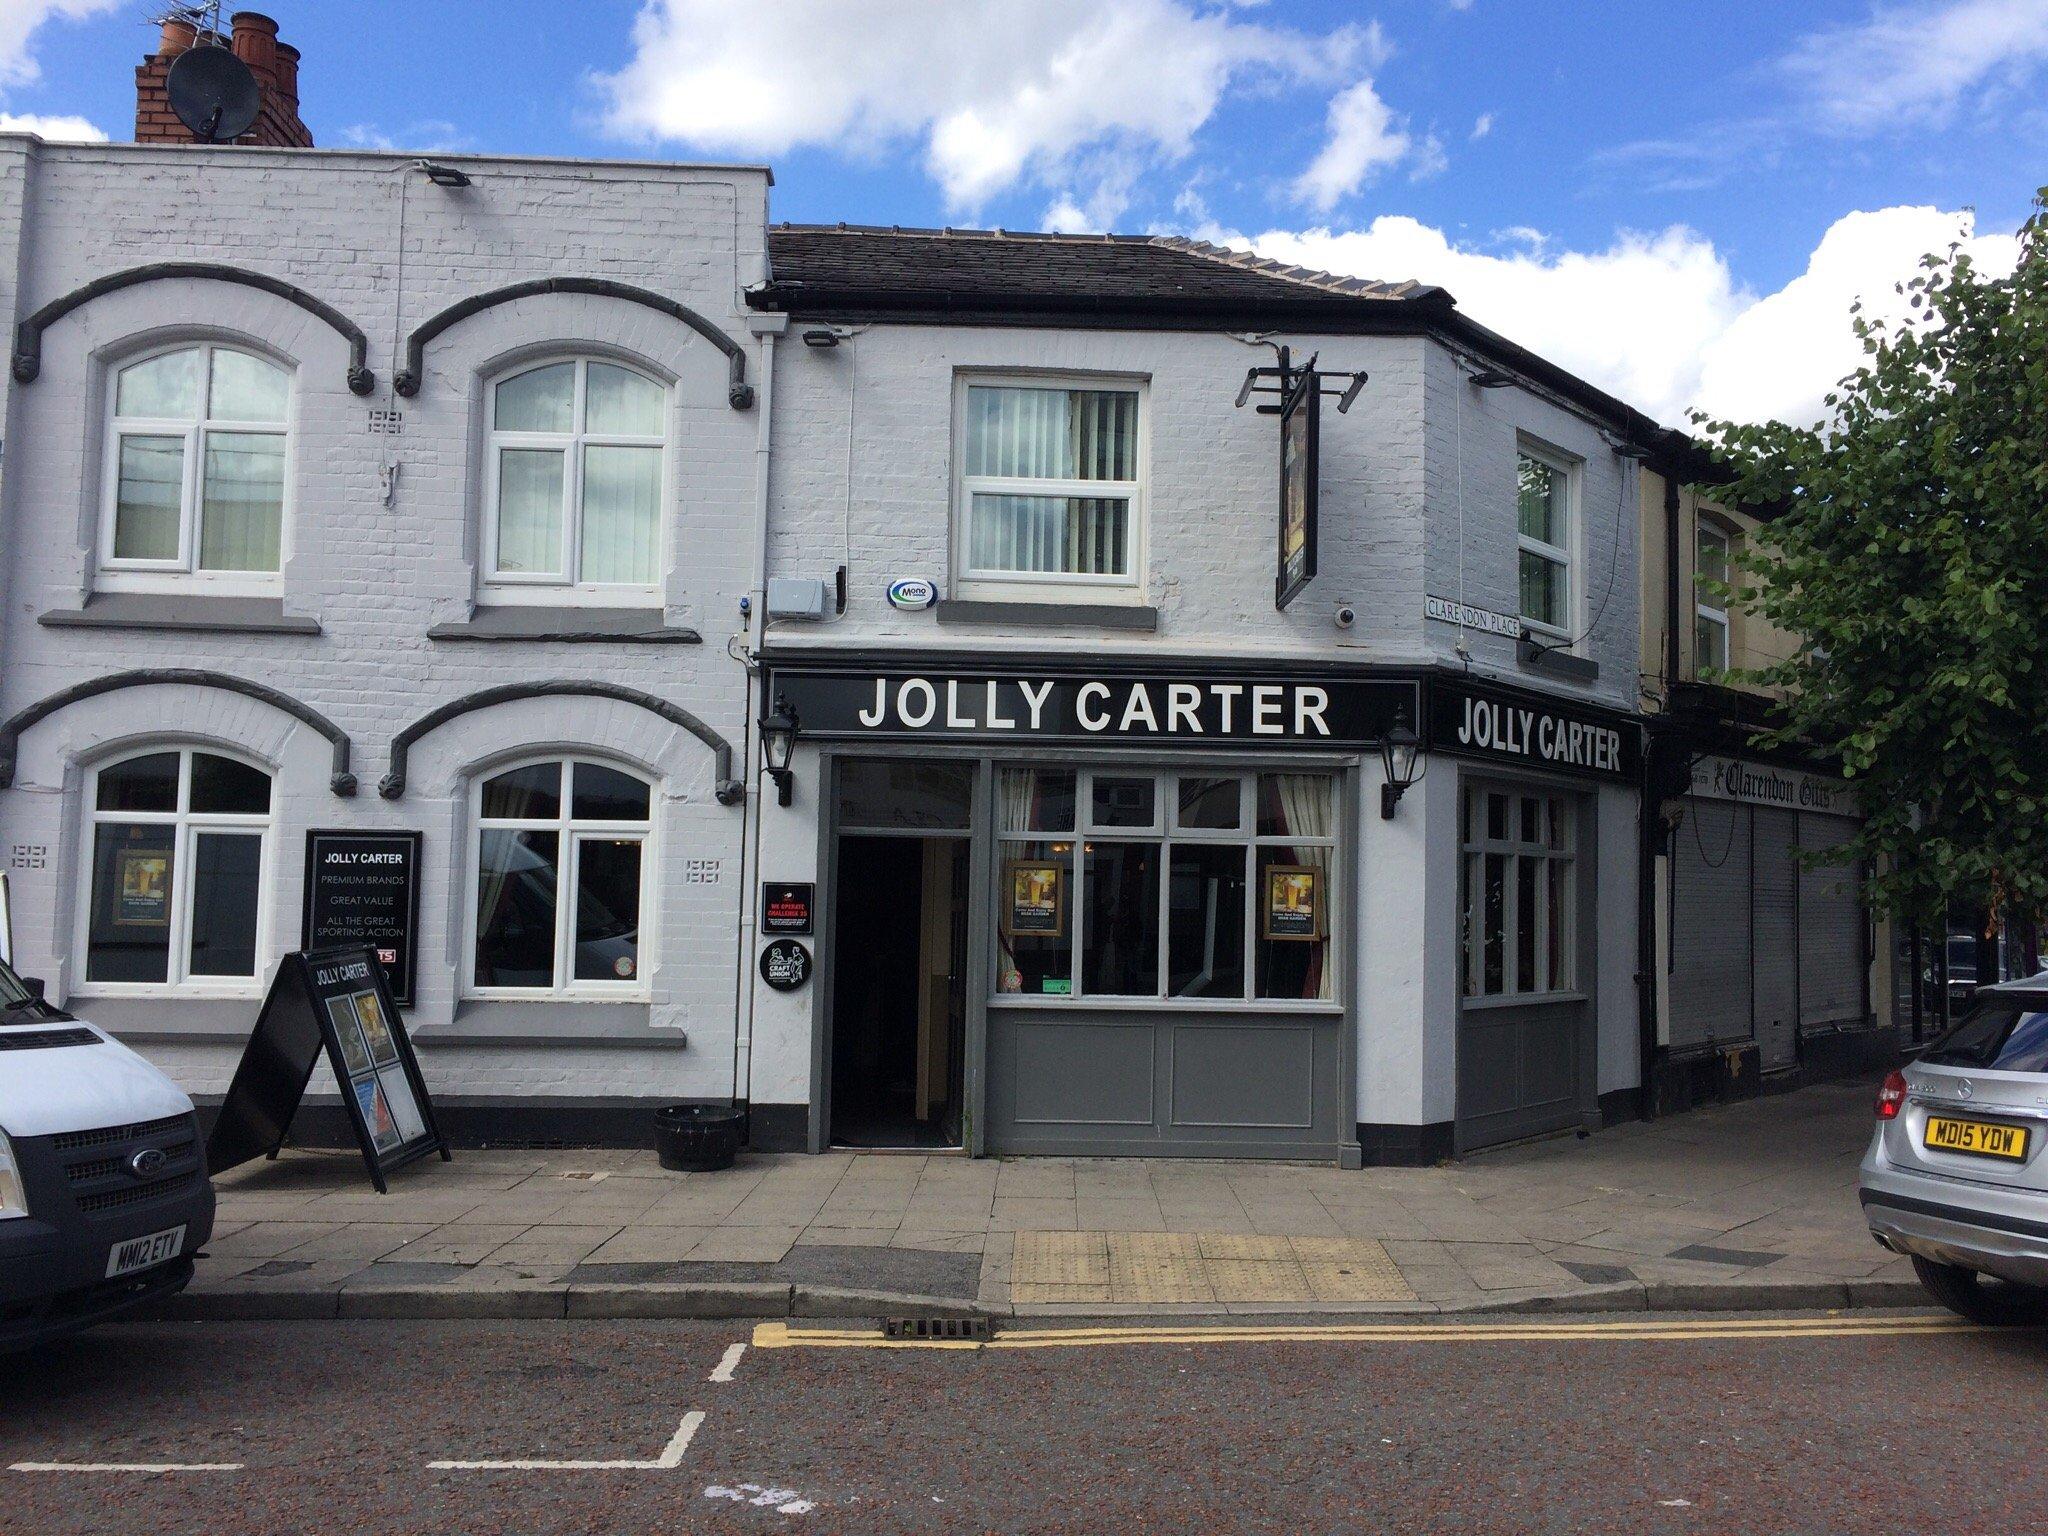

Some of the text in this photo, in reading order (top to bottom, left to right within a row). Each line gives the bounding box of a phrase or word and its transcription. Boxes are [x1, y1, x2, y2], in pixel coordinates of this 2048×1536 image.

[901, 587, 927, 597] Mono
[1427, 599, 1519, 636] CLARENDON PLACE
[858, 677, 1332, 737] JOLLY CARTER
[1457, 697, 1621, 772] JOLLY CARTER
[1725, 759, 1795, 804] Clarendon
[325, 853, 403, 864] JOLLY CARTER
[321, 875, 405, 885] PREMIUM BRANDS
[330, 896, 394, 906] GREAT VALUE
[326, 916, 396, 926] ALL THE GREAT
[317, 927, 404, 937] SPORTING ACTION
[316, 961, 371, 986] JOLLY CARTER
[1935, 1120, 2015, 1153] MD15 YDW
